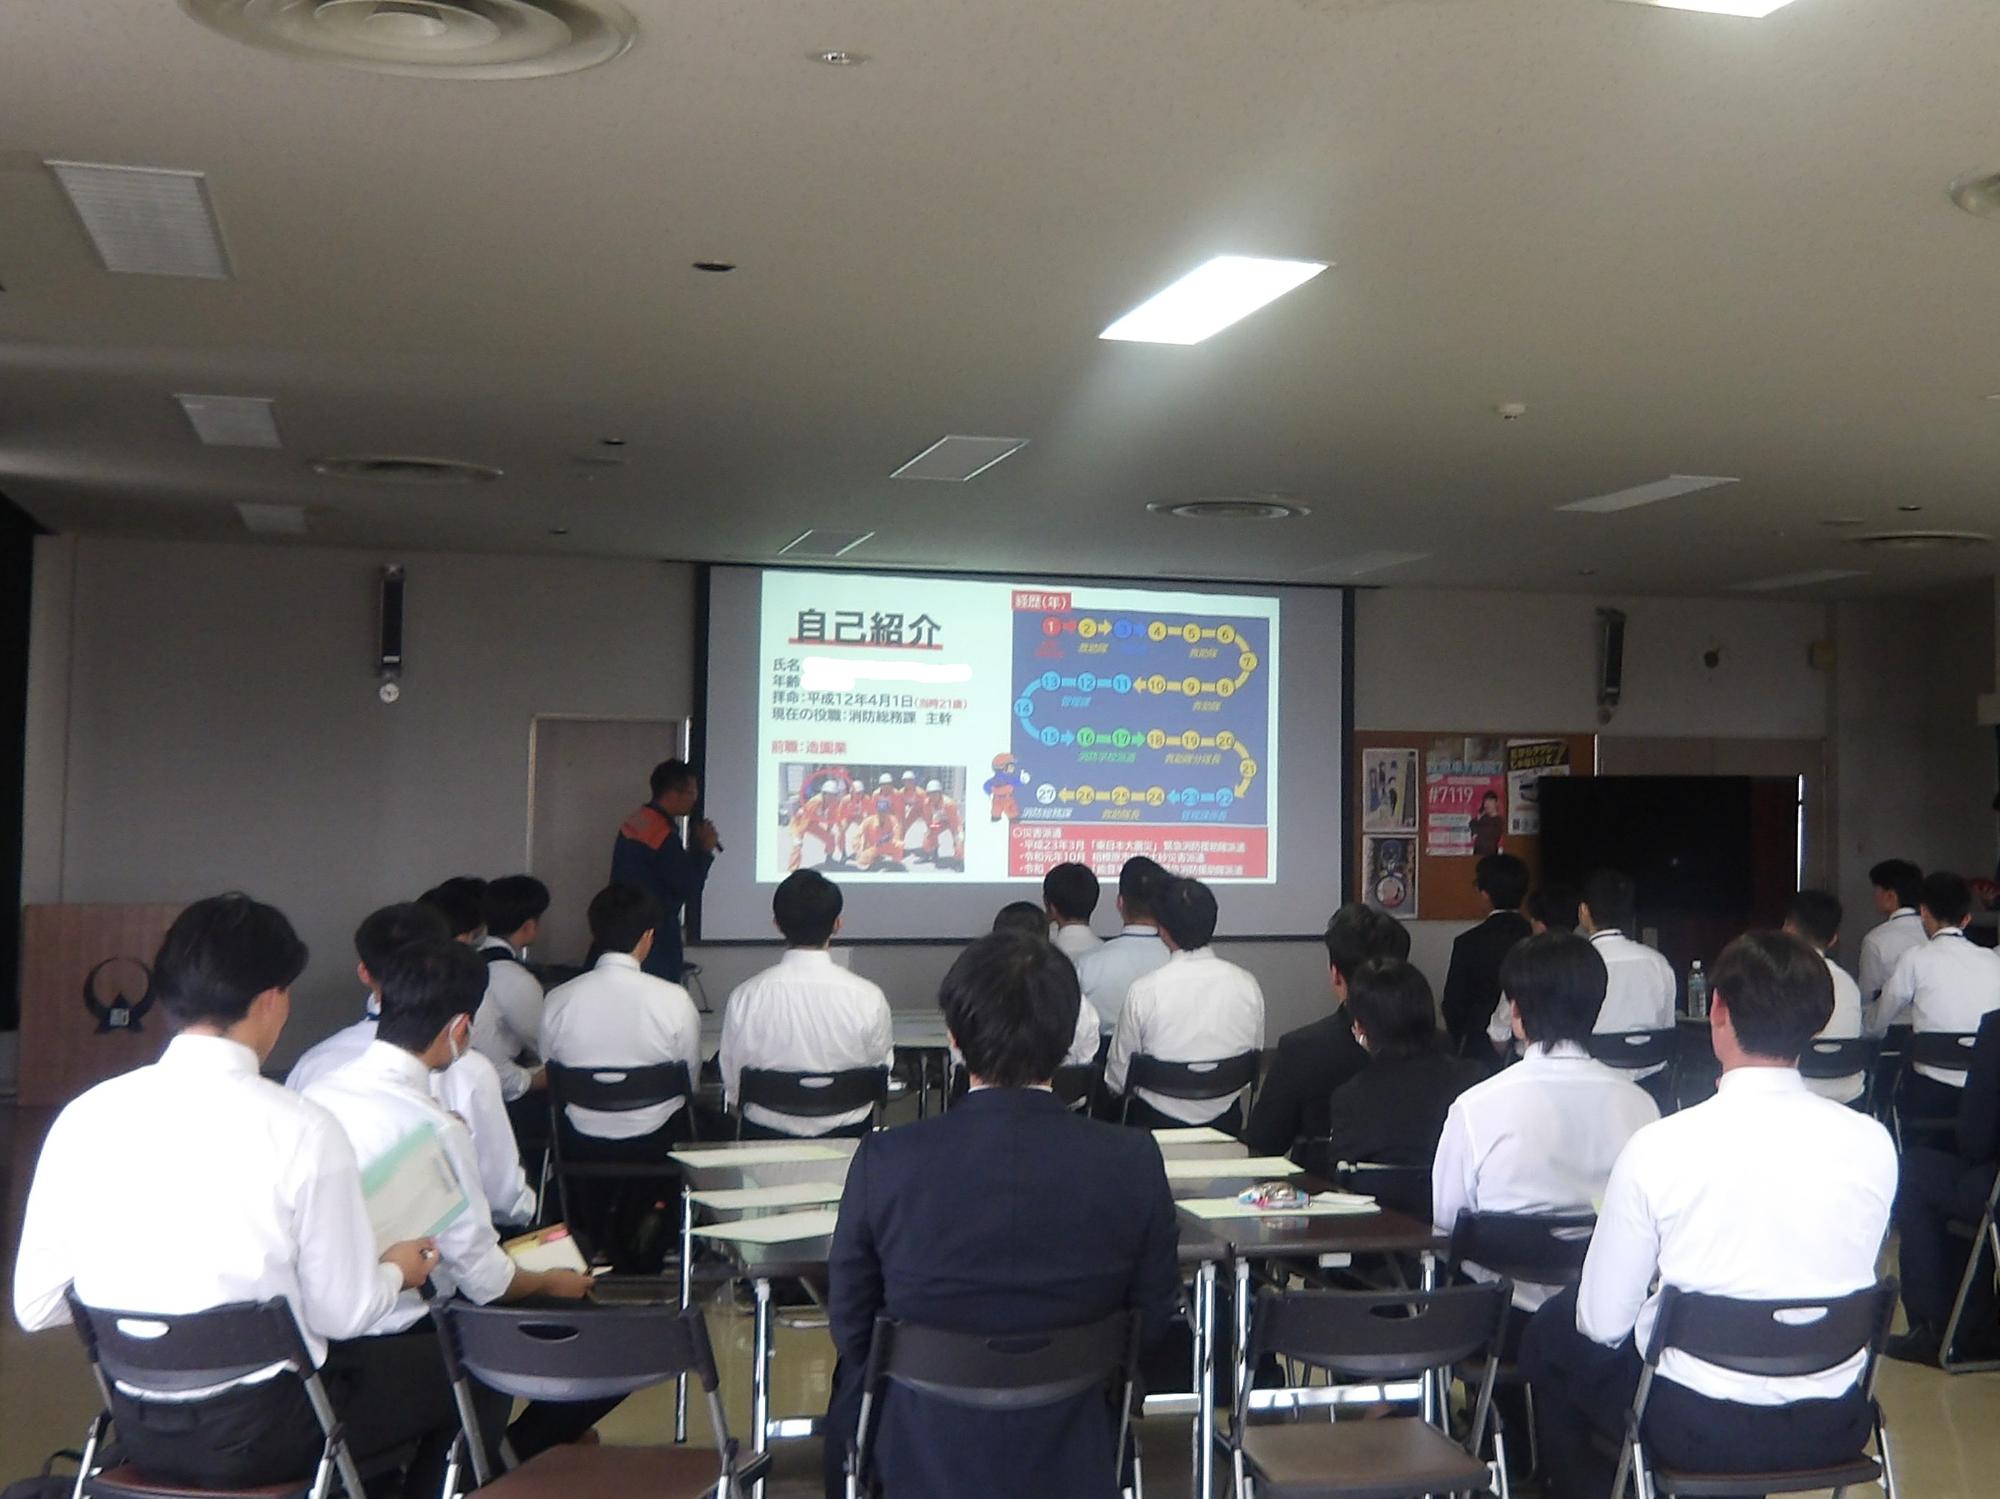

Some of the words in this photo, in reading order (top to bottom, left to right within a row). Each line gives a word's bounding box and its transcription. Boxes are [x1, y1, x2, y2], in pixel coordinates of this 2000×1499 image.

[797, 608, 942, 648] 自己紹介
[773, 658, 800, 672] 氏名
[772, 674, 800, 689] 年齢
[925, 712, 953, 726] 主幹
[1429, 786, 1473, 804] #7119
